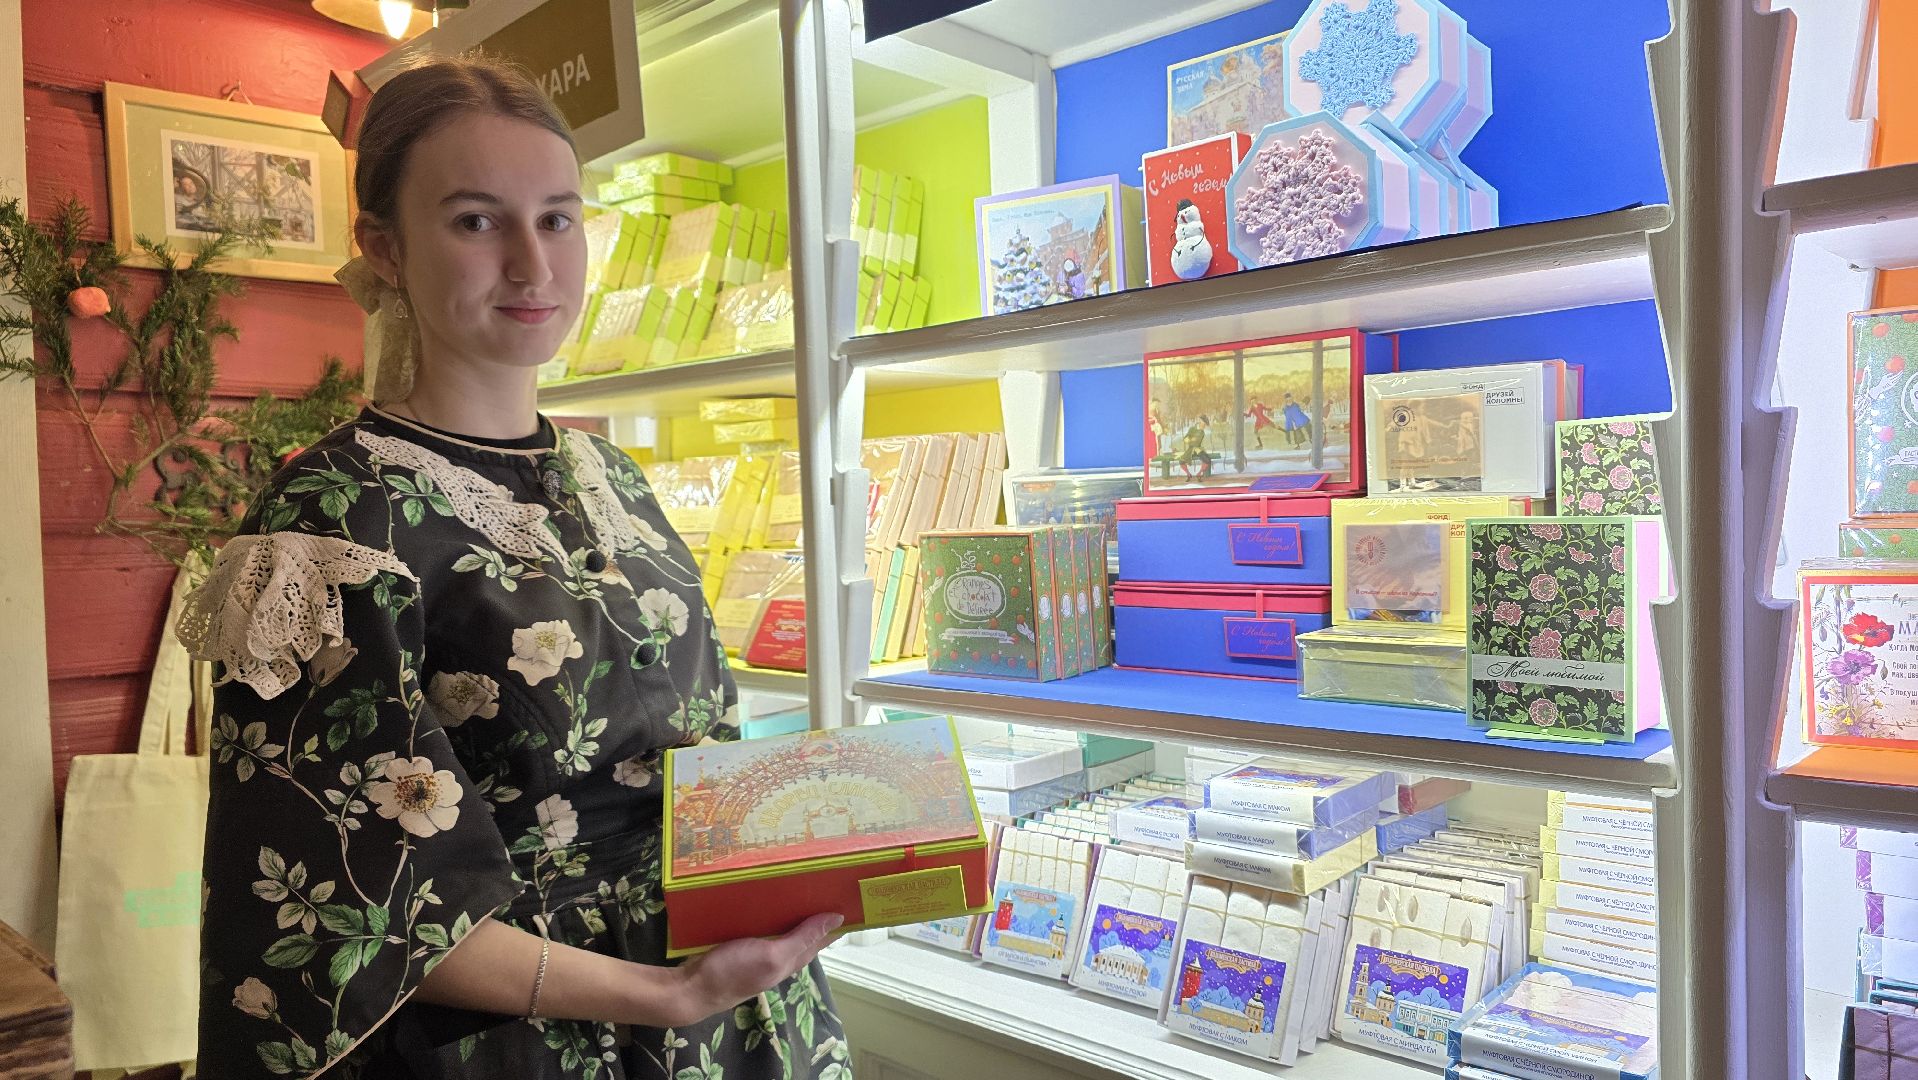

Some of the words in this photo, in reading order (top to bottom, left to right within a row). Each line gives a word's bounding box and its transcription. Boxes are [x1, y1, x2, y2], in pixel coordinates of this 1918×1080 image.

[1148, 180, 1159, 196] С
[1161, 163, 1204, 188] Новым
[1485, 390, 1514, 399] ДРУЗЕЙ
[1486, 397, 1523, 405] КОЛОМНЫ
[1486, 660, 1541, 679] Моей
[1542, 663, 1605, 682] любимой
[1231, 800, 1262, 810] МУФТОВАЯ
[1267, 804, 1291, 812] МАКОМ
[1582, 815, 1613, 824] МУФТОВАЯ
[1216, 831, 1246, 841] МУФТОВАЯ
[1252, 837, 1275, 845] МАКОМ
[1575, 840, 1605, 849] МУФТОВАЯ
[1213, 857, 1244, 868] МУФТОВАЯ
[1249, 864, 1272, 873] МАКОМ
[1578, 866, 1608, 876] МУФТОВАЯ
[1575, 893, 1606, 903] МУФТОВАЯ
[1564, 918, 1593, 929] МУФТОВАЯ
[1561, 945, 1590, 956] МУФТОВАЯ
[1358, 1028, 1393, 1042] МУФТОВАЯ
[1482, 1049, 1515, 1063] МУФТОВАЯ
[1520, 1057, 1546, 1070] ЧЁРНОЙ
